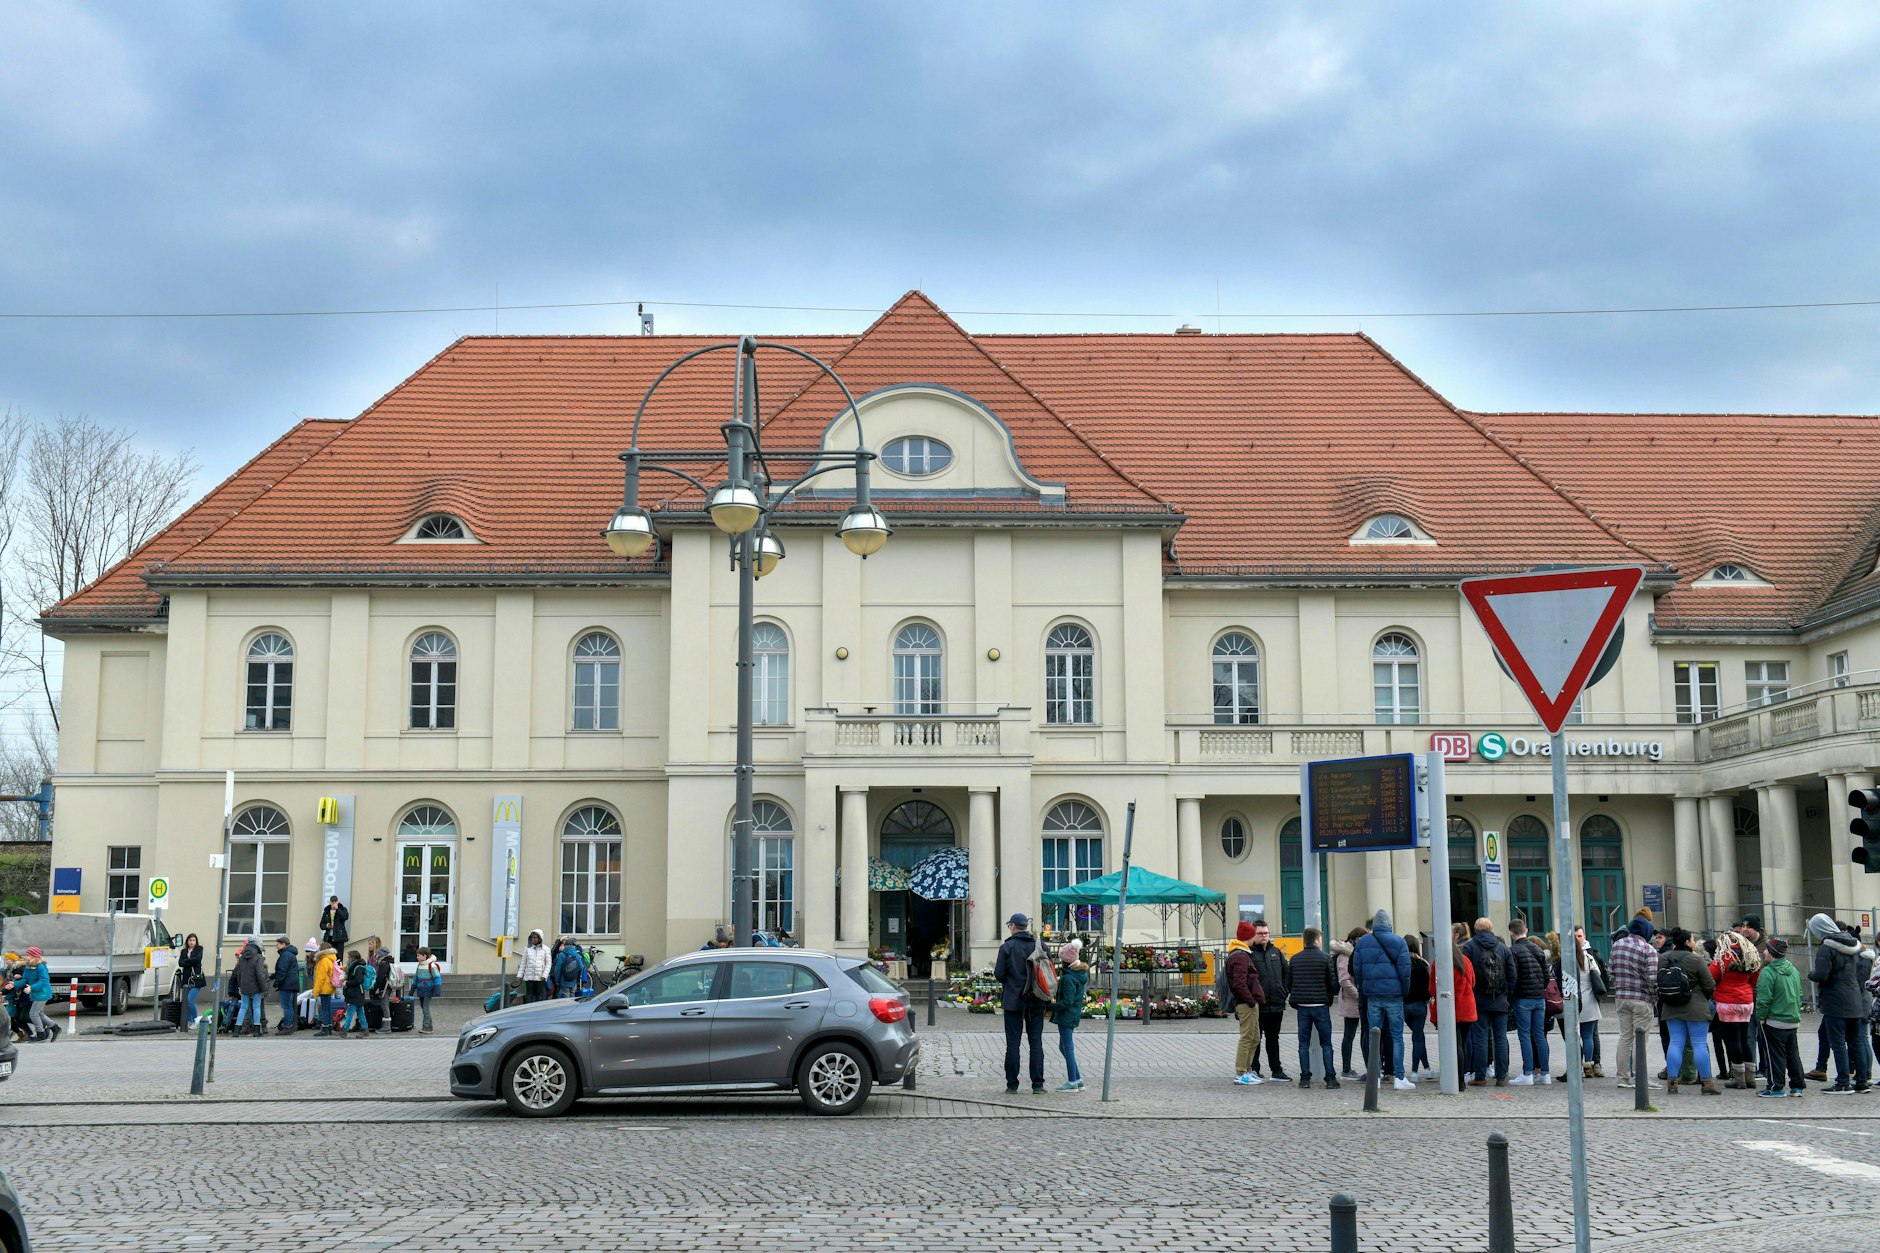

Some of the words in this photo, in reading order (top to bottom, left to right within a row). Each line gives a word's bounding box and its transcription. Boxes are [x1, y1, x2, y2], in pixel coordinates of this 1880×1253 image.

[1437, 738, 1467, 756] DB
[1482, 736, 1505, 758] S
[1511, 737, 1664, 760] Oraienburg
